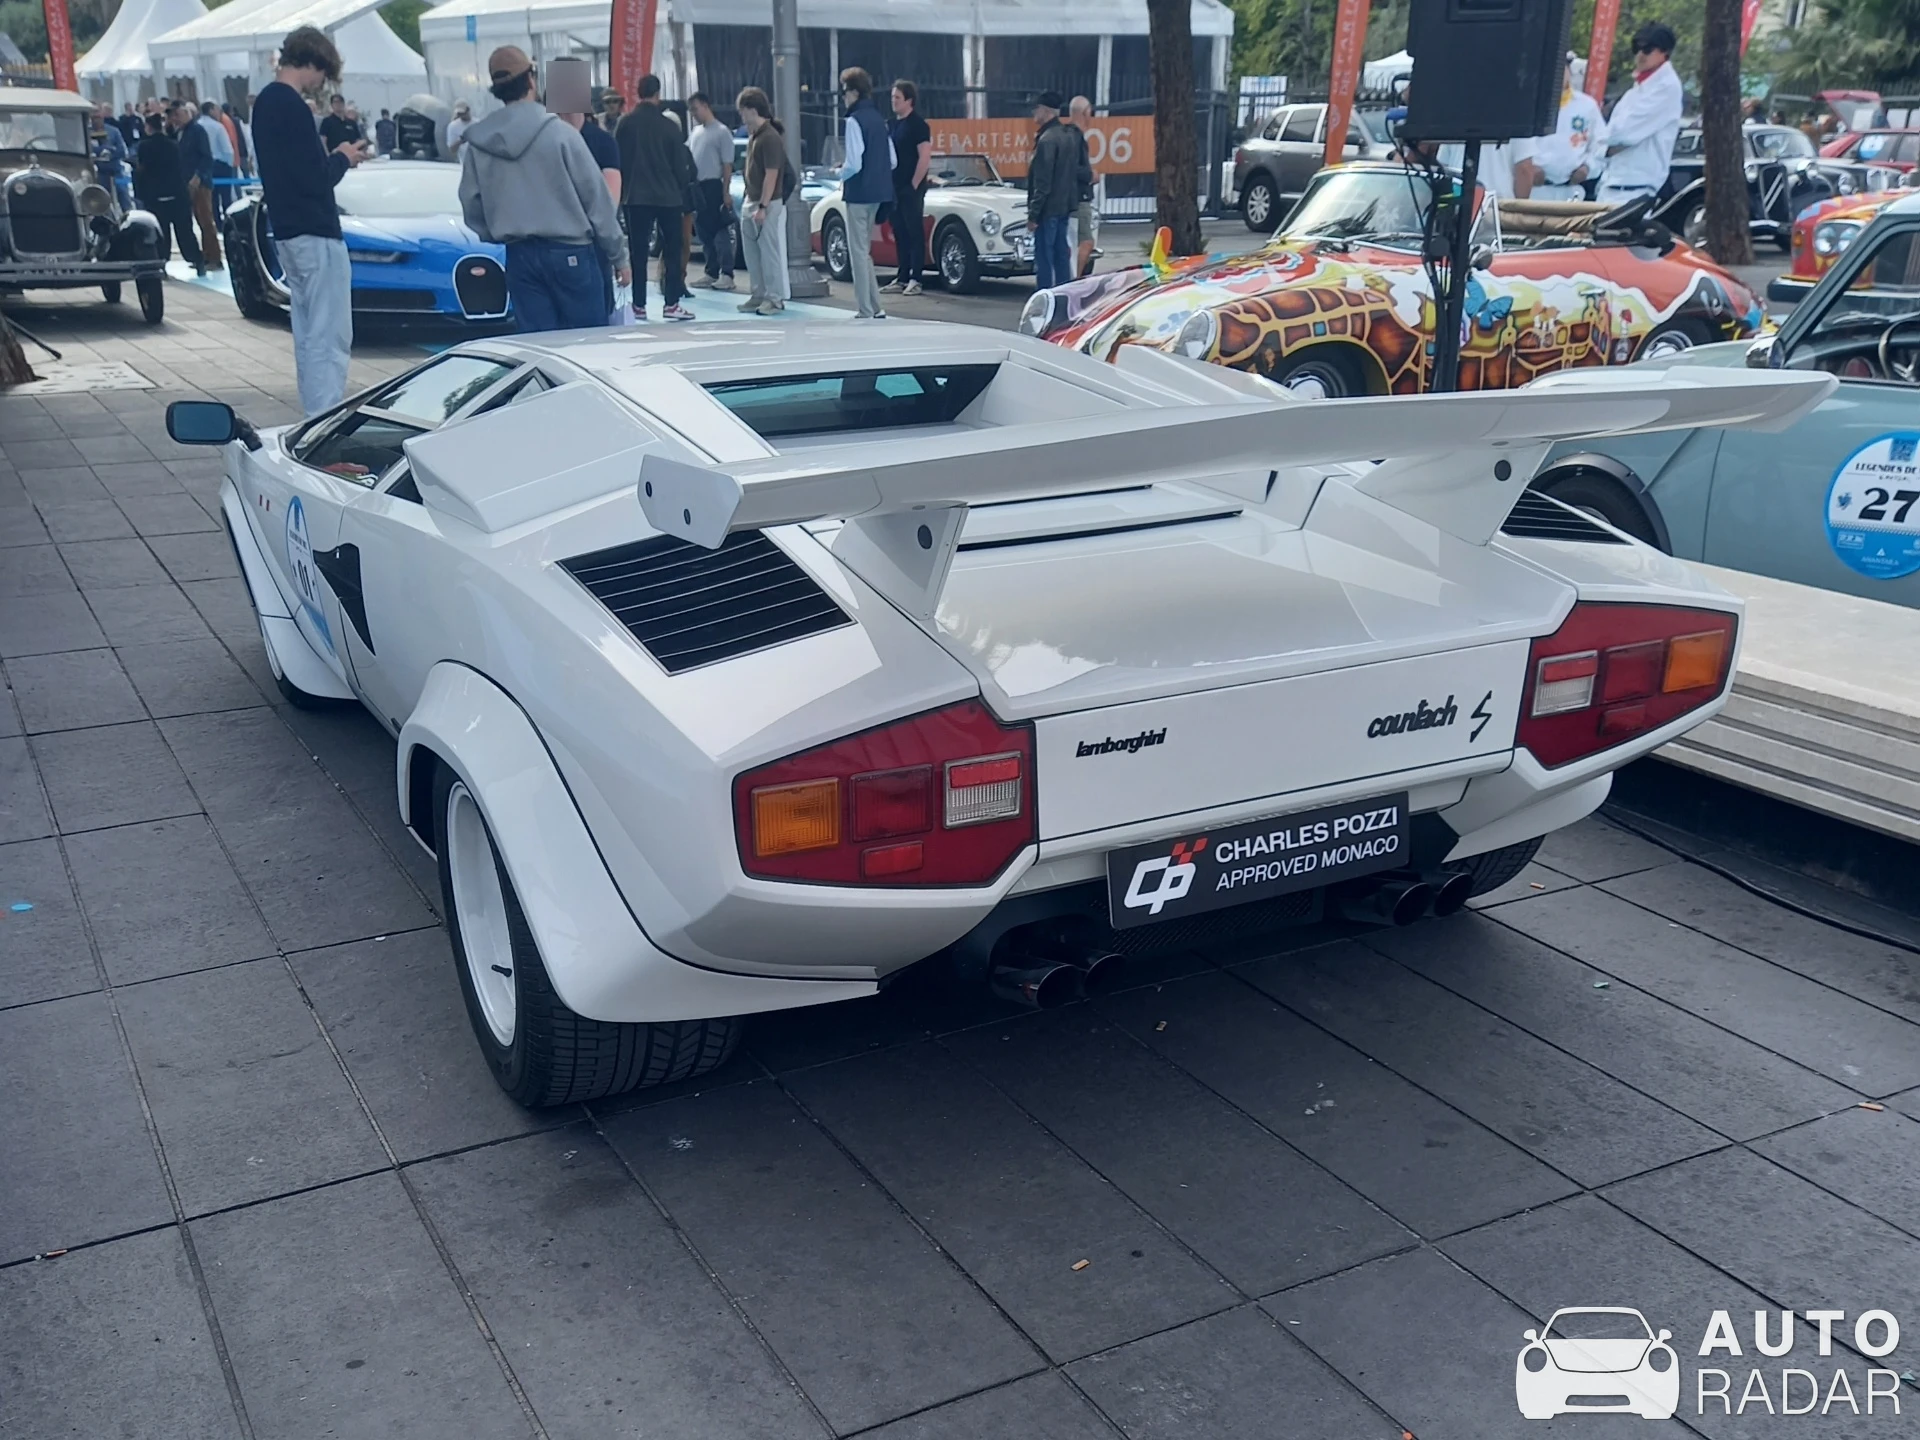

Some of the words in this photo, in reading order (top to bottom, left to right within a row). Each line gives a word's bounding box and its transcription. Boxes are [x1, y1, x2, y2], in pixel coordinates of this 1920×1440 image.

[930, 130, 1037, 148] ÉPARTEM
[1084, 127, 1133, 165] 06
[1858, 487, 1920, 523] 27
[1367, 694, 1458, 738] countach
[1076, 727, 1167, 758] lamborghini
[1215, 821, 1329, 863] CHARLES
[1333, 806, 1398, 839] POZZI
[1215, 853, 1317, 892] APPROVED
[1320, 834, 1399, 869] MONACO
